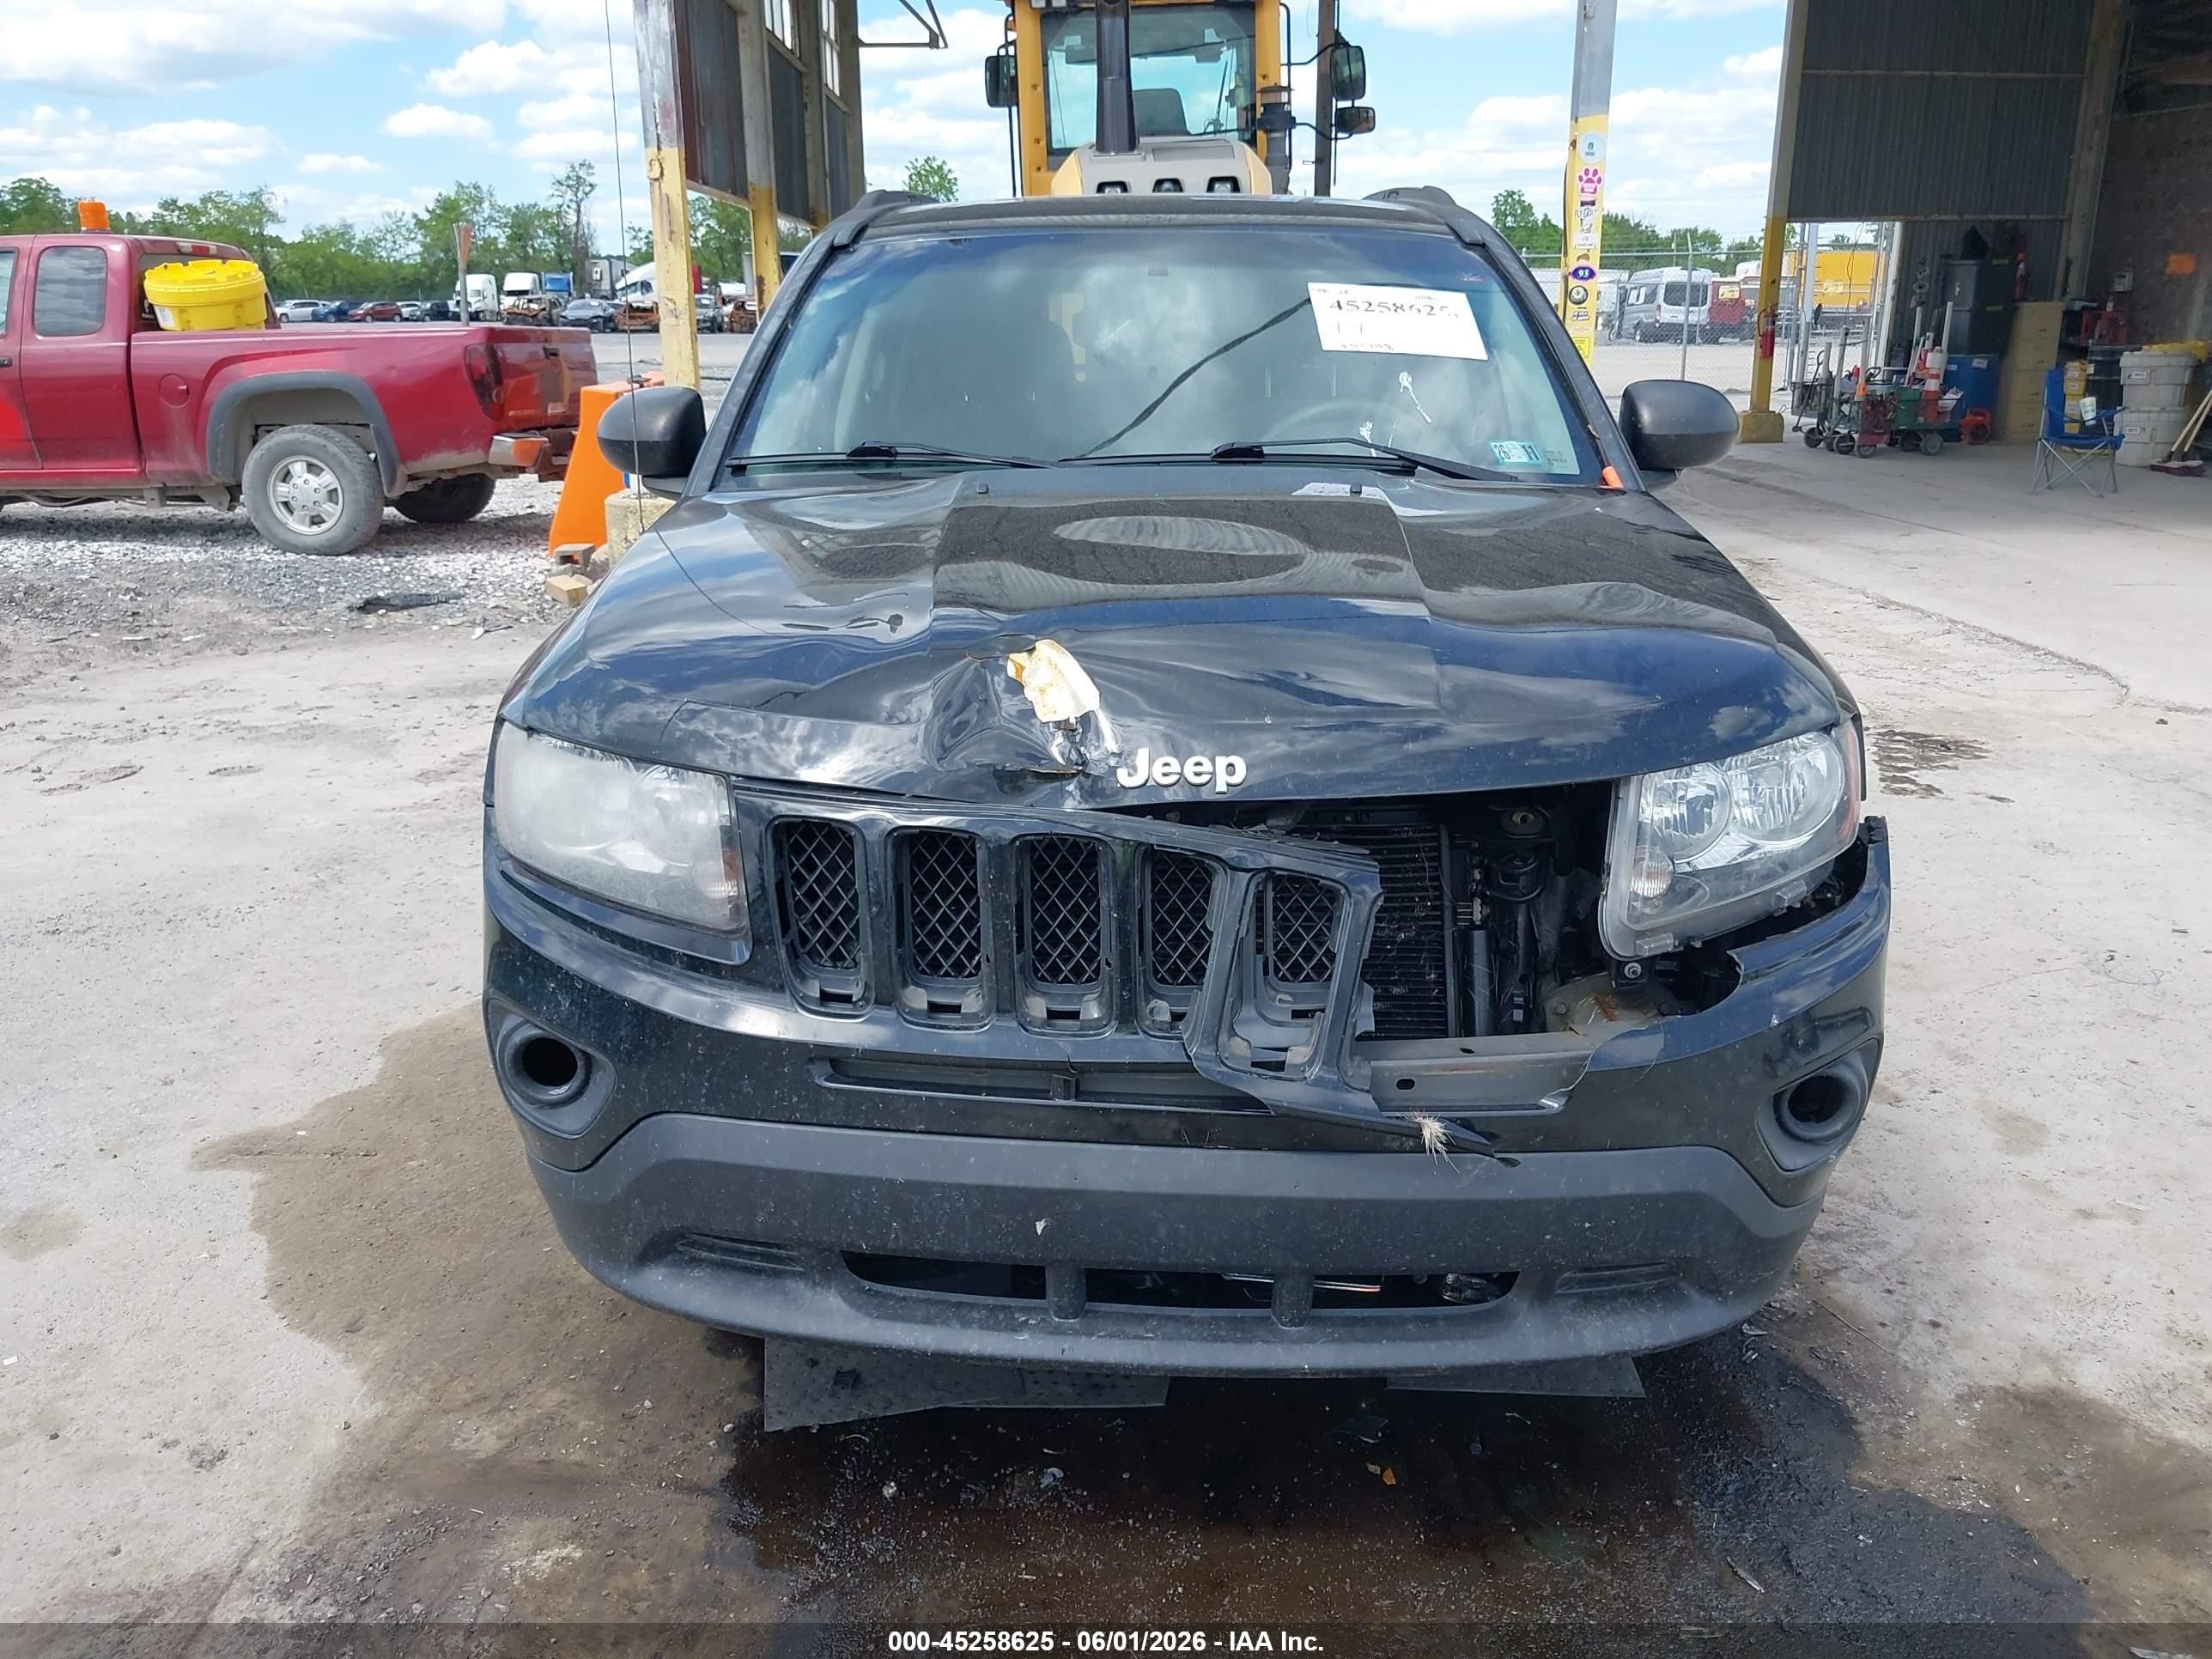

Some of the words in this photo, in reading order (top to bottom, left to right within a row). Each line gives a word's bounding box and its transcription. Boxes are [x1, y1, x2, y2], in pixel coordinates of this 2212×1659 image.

[1577, 269, 1589, 278] 93
[1493, 444, 1510, 460] 26
[1521, 444, 1540, 461] 11
[1116, 747, 1248, 794] Jeep
